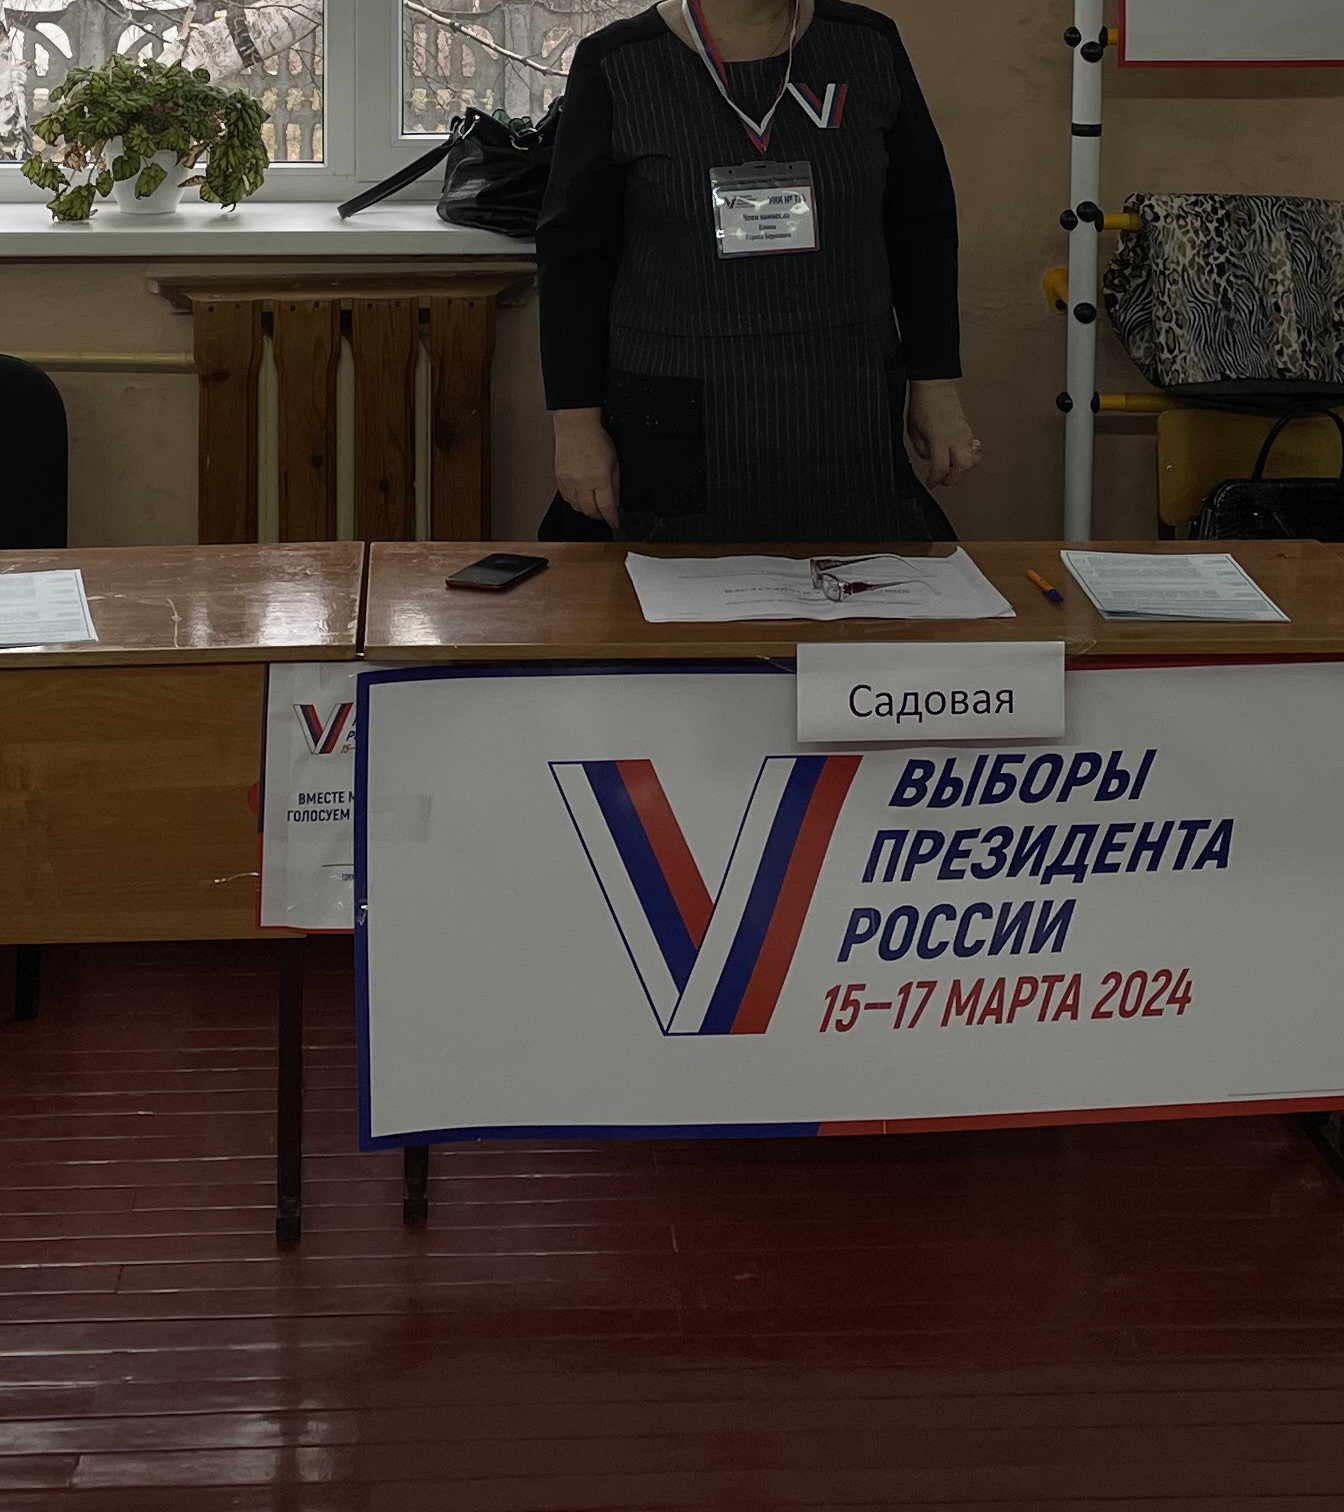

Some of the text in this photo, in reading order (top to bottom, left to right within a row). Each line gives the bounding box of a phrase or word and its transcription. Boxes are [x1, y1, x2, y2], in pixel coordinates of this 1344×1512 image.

[848, 683, 1015, 725] Садовая
[298, 791, 345, 805] ВМЕСТЕ
[888, 748, 1159, 810] ВЫБОРЫ
[287, 808, 350, 822] ГОЛОСУЕМ
[862, 816, 1234, 887] ПРЕЗИДЕНТА
[837, 900, 1074, 963] РОССИИ
[942, 974, 1083, 1028] МАРТА
[1090, 968, 1193, 1021] 2024
